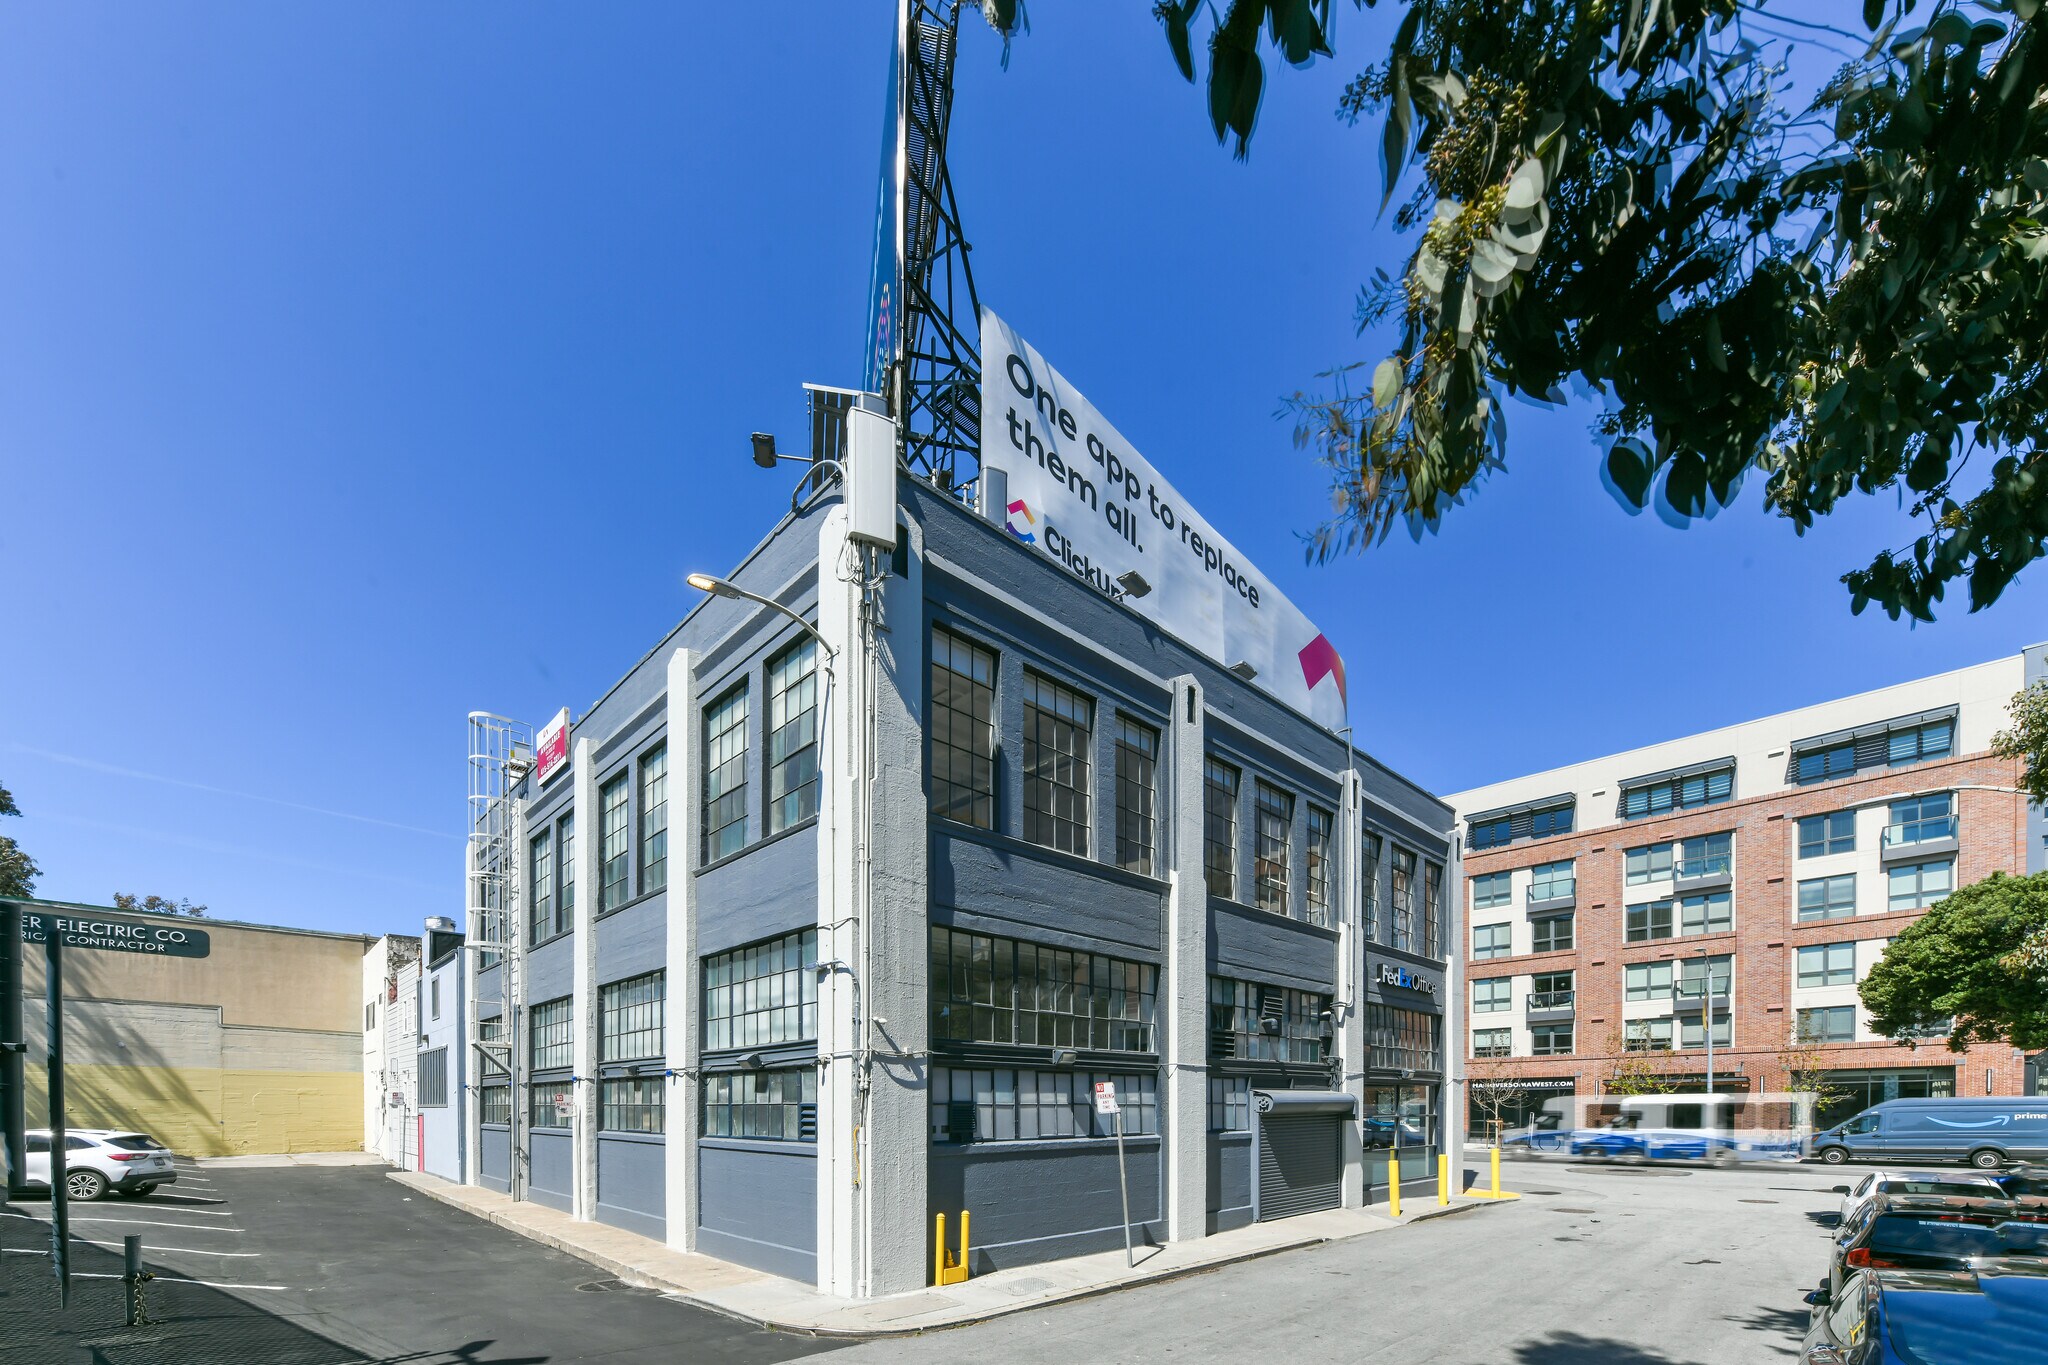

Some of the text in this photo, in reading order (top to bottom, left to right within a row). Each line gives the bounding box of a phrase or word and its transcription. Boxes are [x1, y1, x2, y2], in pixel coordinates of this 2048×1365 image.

[1006, 406, 1144, 554] them all.
[1006, 353, 1260, 609] One app to replace
[56, 918, 147, 940] ELECTRIC
[155, 929, 189, 944] CO.
[66, 935, 166, 952] CONTRACTOR
[1382, 963, 1437, 995] FedEx Office
[2014, 1112, 2048, 1121] prime
